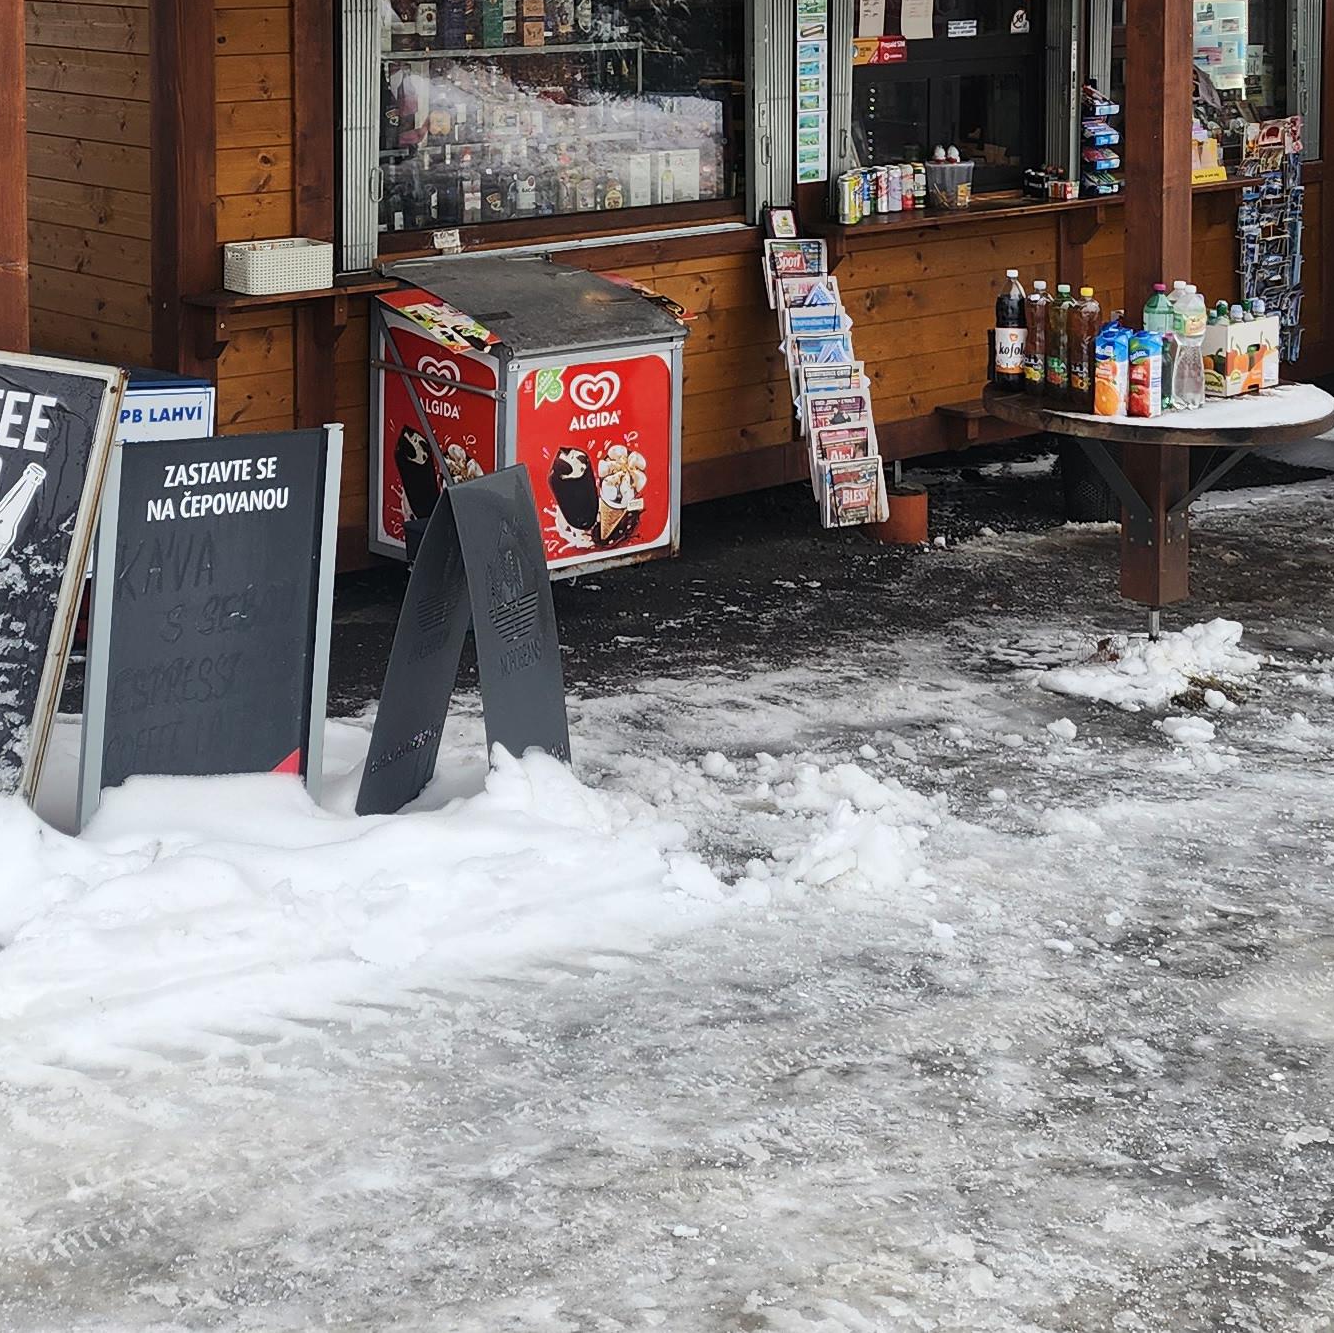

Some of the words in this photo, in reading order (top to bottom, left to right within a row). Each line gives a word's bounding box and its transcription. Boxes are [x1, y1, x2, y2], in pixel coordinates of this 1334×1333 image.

[999, 341, 1025, 358] kofol
[119, 409, 143, 423] PB
[149, 400, 203, 423] LAHVÍ
[569, 411, 620, 432] ALGIDA
[164, 458, 252, 487] ZASTAVTE
[256, 456, 277, 480] SE
[147, 498, 175, 522] NA
[180, 487, 289, 519] ČEPOVANOU
[842, 489, 869, 505] BLESK
